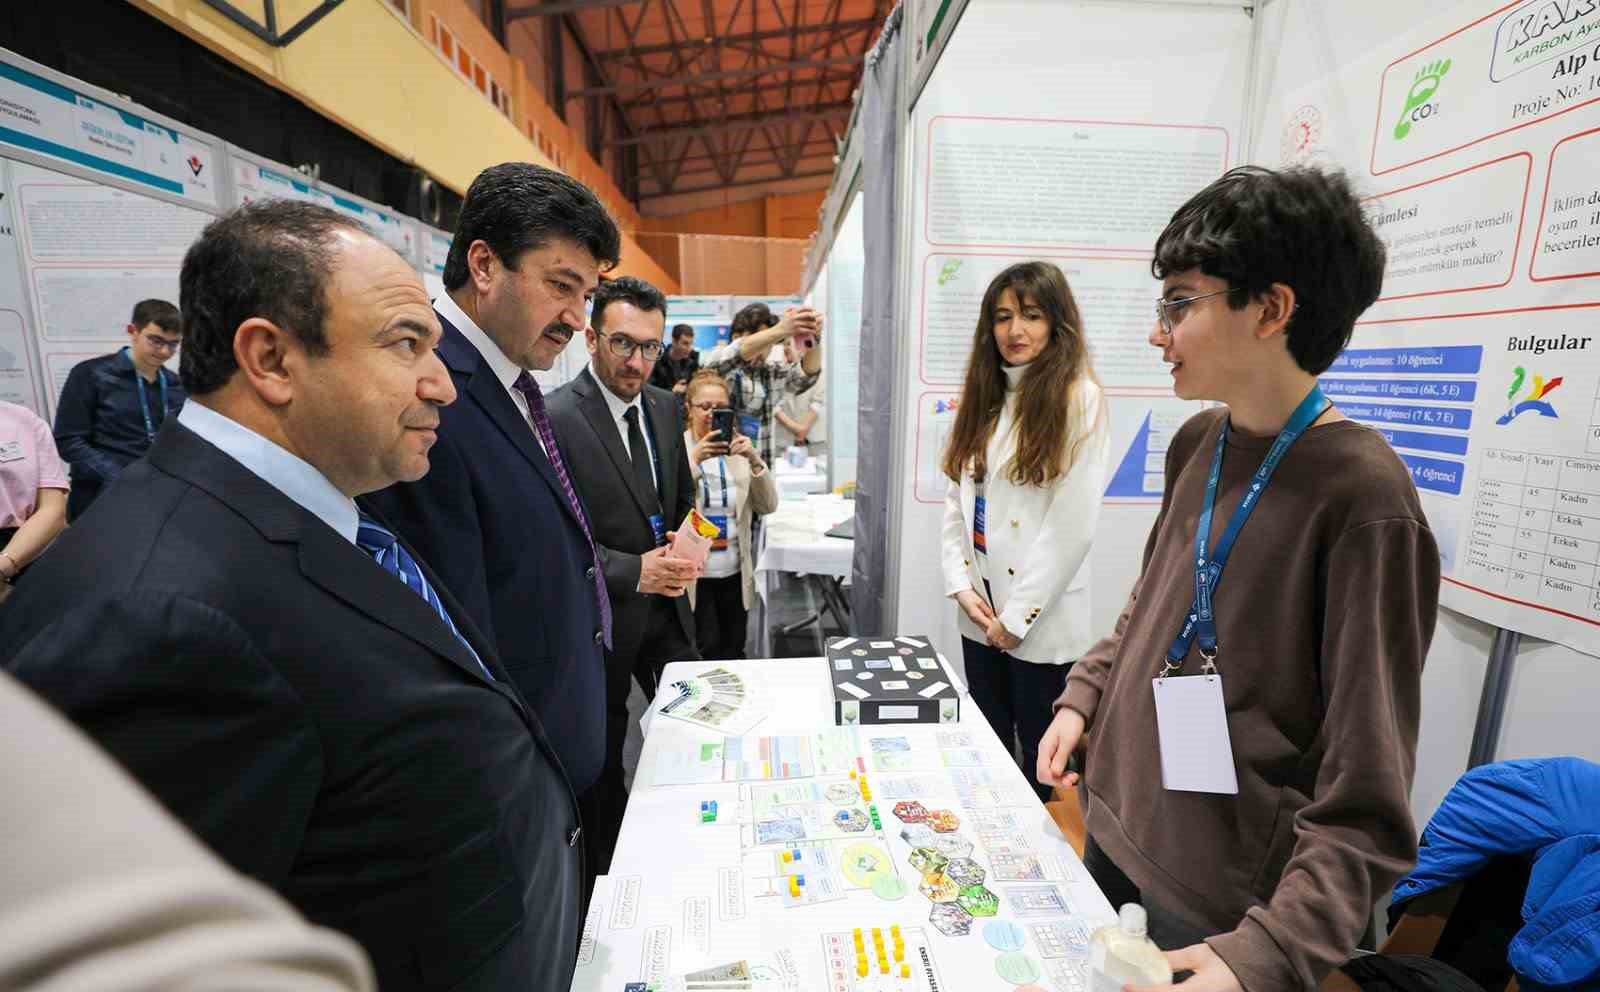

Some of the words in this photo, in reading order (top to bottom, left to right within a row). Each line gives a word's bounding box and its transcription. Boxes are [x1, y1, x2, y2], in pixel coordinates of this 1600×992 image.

[1513, 30, 1573, 64] KARBON
[1551, 54, 1587, 80] Alp
[1512, 95, 1551, 119] Proje
[1556, 84, 1582, 104] No:
[1475, 208, 1514, 232] temelli
[1548, 218, 1578, 236] oyun
[1507, 334, 1592, 355] Bulgular
[1397, 354, 1408, 366] 10
[1408, 352, 1443, 368] öğrenci
[1415, 466, 1422, 478] 4
[1423, 467, 1456, 484] öğrenci
[1560, 493, 1589, 504] Kadın
[1556, 515, 1583, 527] Erkek
[1552, 536, 1579, 548] Erkek
[1548, 557, 1577, 570] Kadın
[1544, 578, 1573, 592] Kadın
